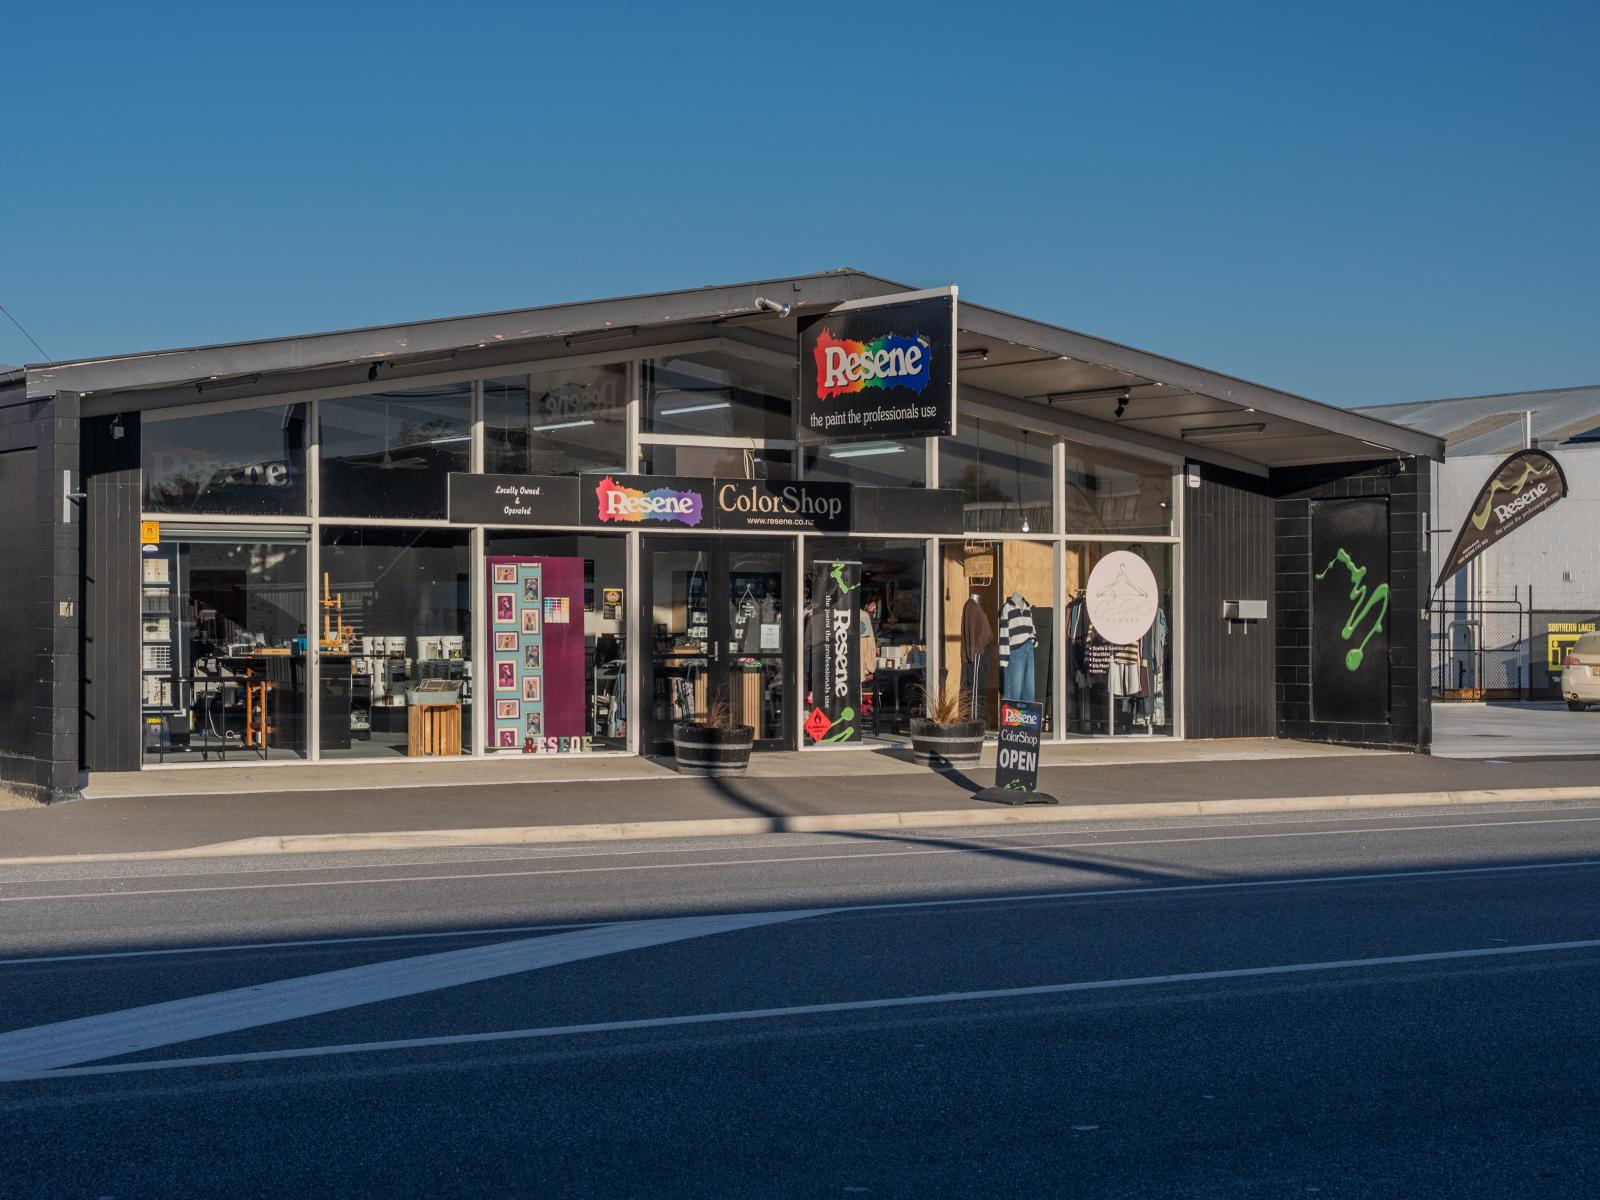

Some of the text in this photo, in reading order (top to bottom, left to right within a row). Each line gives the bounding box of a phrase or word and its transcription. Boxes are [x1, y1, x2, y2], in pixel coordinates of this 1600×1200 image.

[824, 345, 923, 388] Resene
[810, 403, 937, 429] the paint the professionals use
[495, 485, 540, 496] Locally Owned
[606, 490, 695, 515] Resene
[719, 484, 842, 520] ColorShop
[504, 506, 532, 516] Operated
[1493, 482, 1548, 524] Resene
[747, 518, 814, 526] www.resene.co.nz
[1548, 623, 1596, 632] SOUTHERN LAKES
[833, 608, 851, 698] Resene
[824, 644, 832, 695] professionals
[1005, 708, 1038, 725] Resene
[1001, 728, 1038, 747] ColorShop
[999, 748, 1037, 772] OPEN
